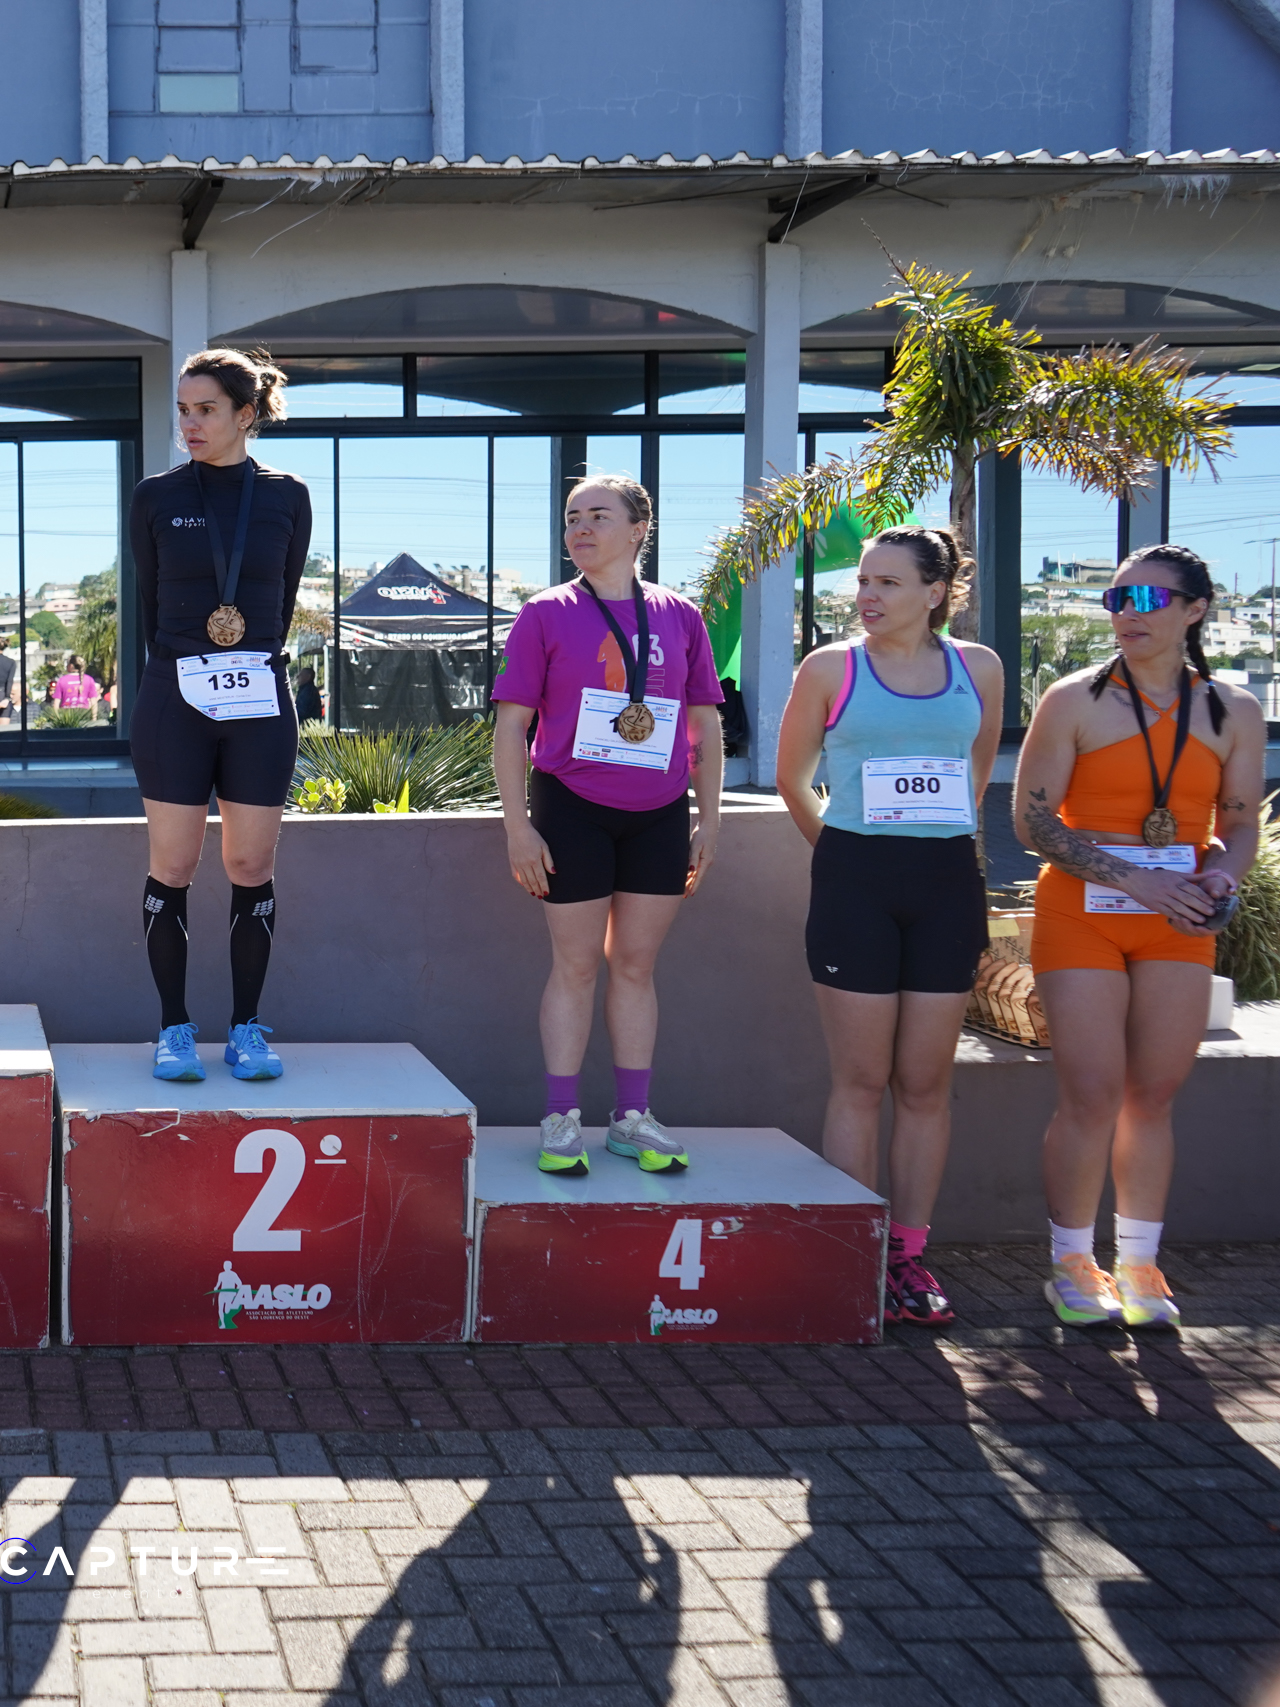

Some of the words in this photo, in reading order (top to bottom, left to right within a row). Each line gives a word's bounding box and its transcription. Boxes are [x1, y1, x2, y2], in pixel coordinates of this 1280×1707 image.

[208, 671, 250, 691] 135
[895, 777, 941, 794] 080
[230, 1284, 331, 1310] AASLO
[661, 1308, 718, 1324] AASLO
